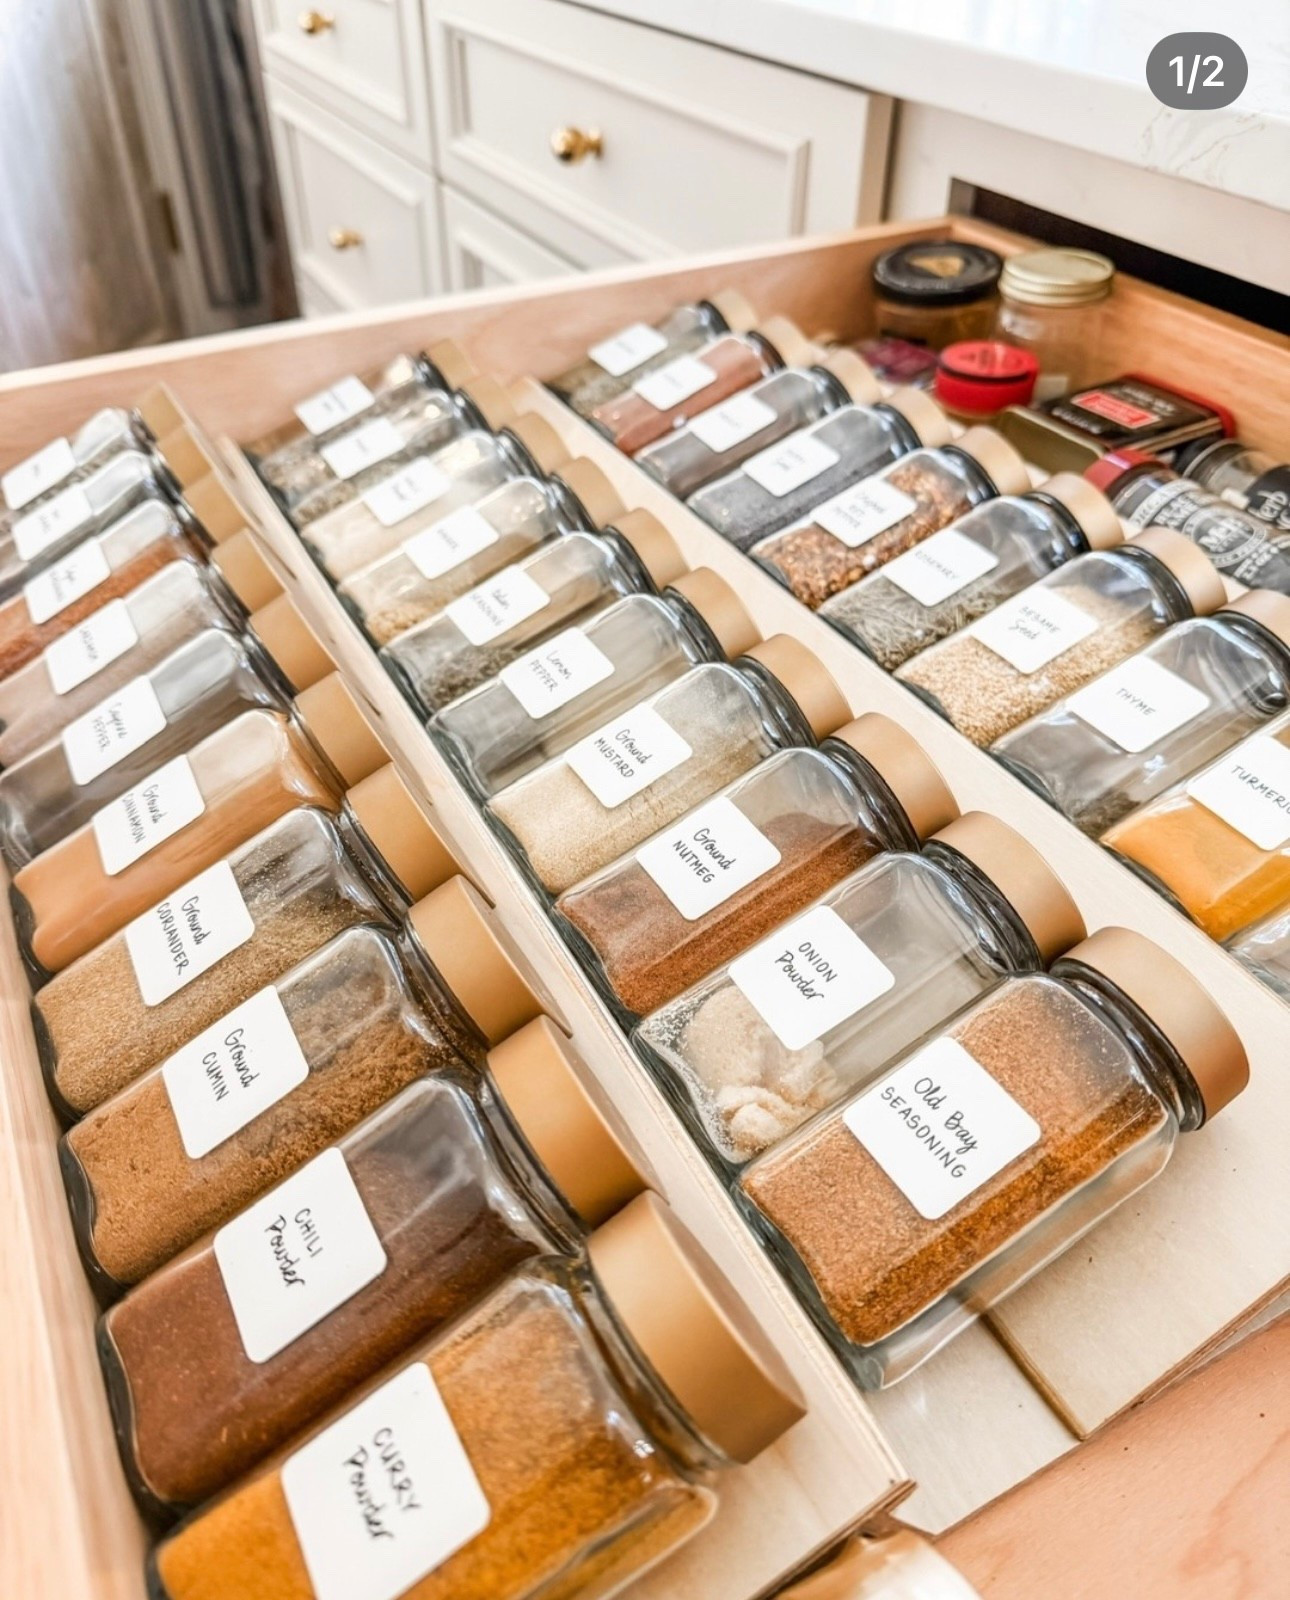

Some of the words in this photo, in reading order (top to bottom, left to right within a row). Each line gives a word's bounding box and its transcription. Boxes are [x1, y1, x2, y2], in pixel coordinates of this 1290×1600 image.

[1008, 620, 1037, 641] Seed
[1018, 605, 1061, 635] SESAME
[528, 658, 559, 693] PEPPER
[544, 650, 573, 680] Lemon
[1114, 686, 1157, 717] THYME
[592, 736, 635, 780] MUSTARD
[615, 728, 654, 766] Ground
[122, 792, 146, 845] CINNAMON
[141, 783, 162, 825] Ground
[672, 840, 715, 884] NUTMEG
[693, 827, 735, 871] Ground
[156, 902, 191, 977] CORIANDER
[180, 895, 211, 947] Ground
[774, 949, 825, 1001] Powder
[798, 940, 838, 982] ONION
[201, 1051, 230, 1103] CUMIN
[223, 1027, 262, 1089] Ground
[880, 1086, 967, 1179] SEASONING
[914, 1077, 947, 1110] Old
[944, 1110, 978, 1155] Bay
[264, 1214, 306, 1287] Powder
[294, 1207, 324, 1258] CHILI
[341, 1445, 396, 1540] Powder
[373, 1426, 422, 1512] CURRY
